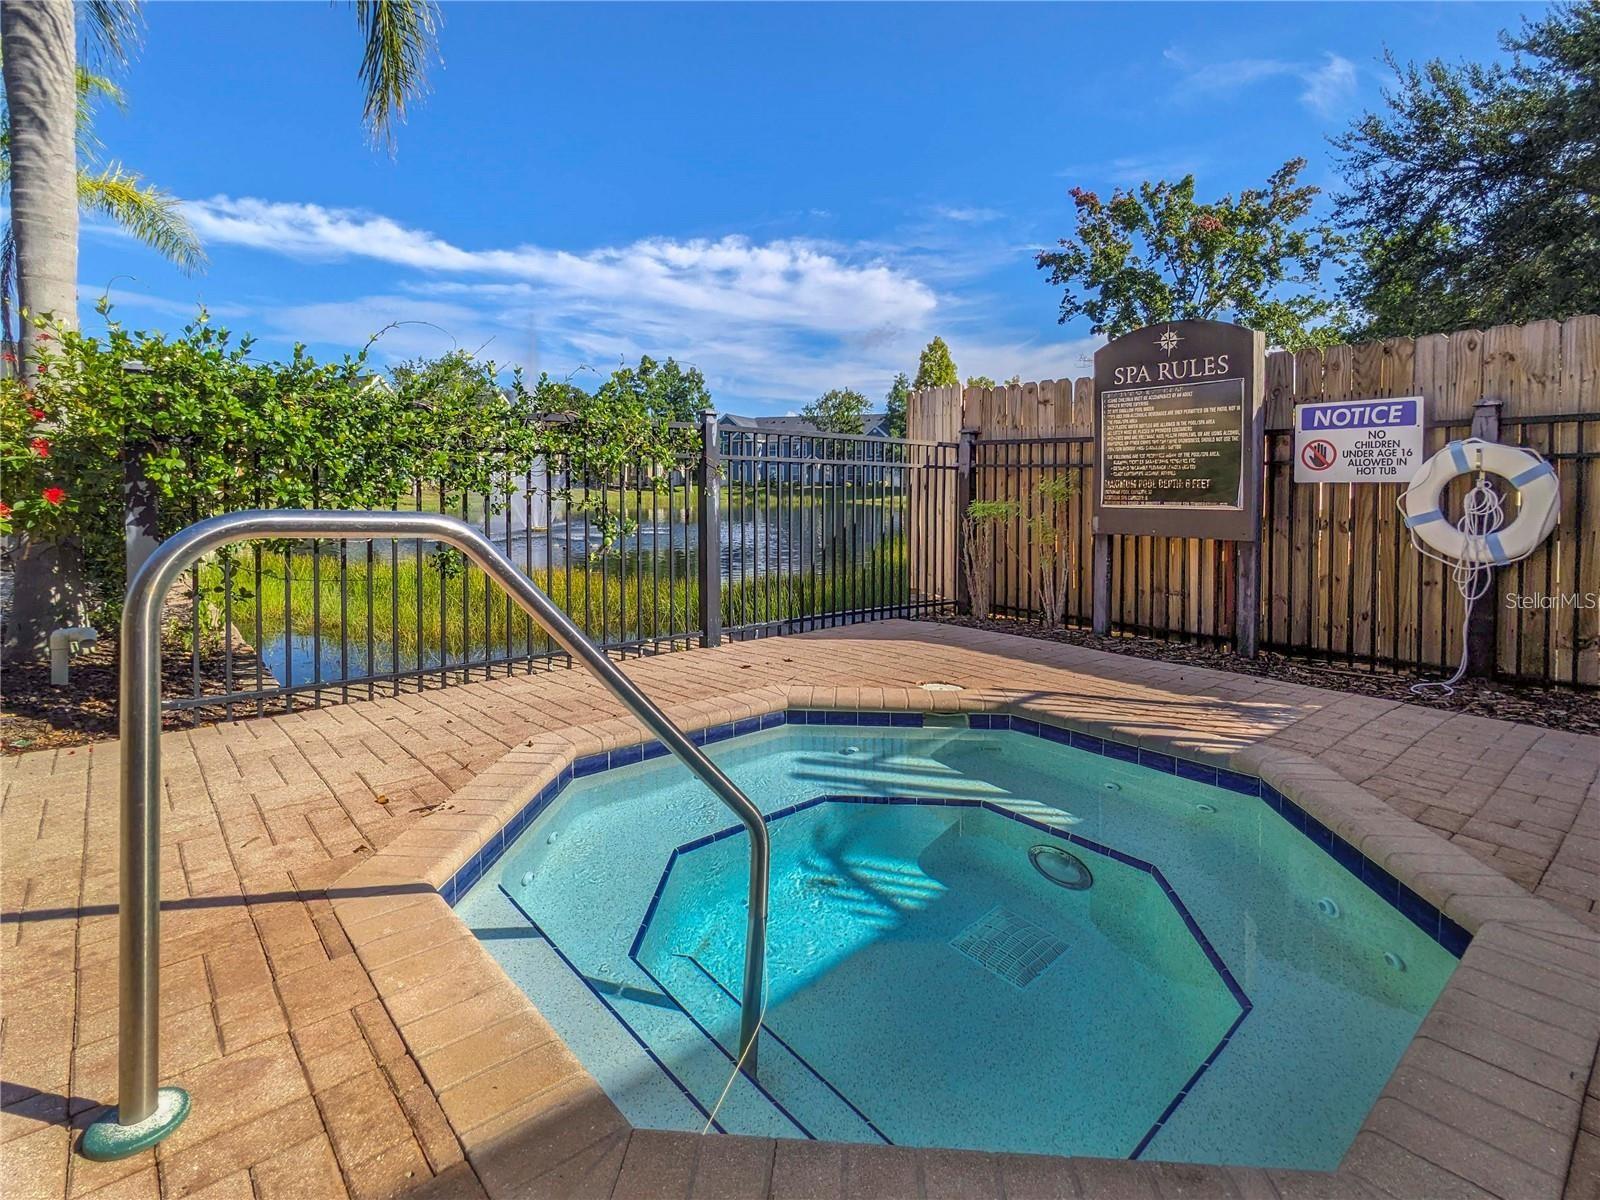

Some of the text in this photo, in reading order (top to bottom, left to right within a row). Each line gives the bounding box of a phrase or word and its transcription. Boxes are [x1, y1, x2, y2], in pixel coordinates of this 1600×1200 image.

[1114, 355, 1229, 385] SPA RULES
[1314, 405, 1403, 427] NOTICE
[1368, 430, 1386, 439] NO
[1354, 440, 1400, 449] CHILDREN
[1342, 448, 1412, 458] UNDER AGE 16
[1348, 458, 1393, 466] ALLOWED
[1356, 467, 1376, 475] HOT
[1138, 479, 1156, 488] POOL
[1192, 479, 1211, 488] FEET
